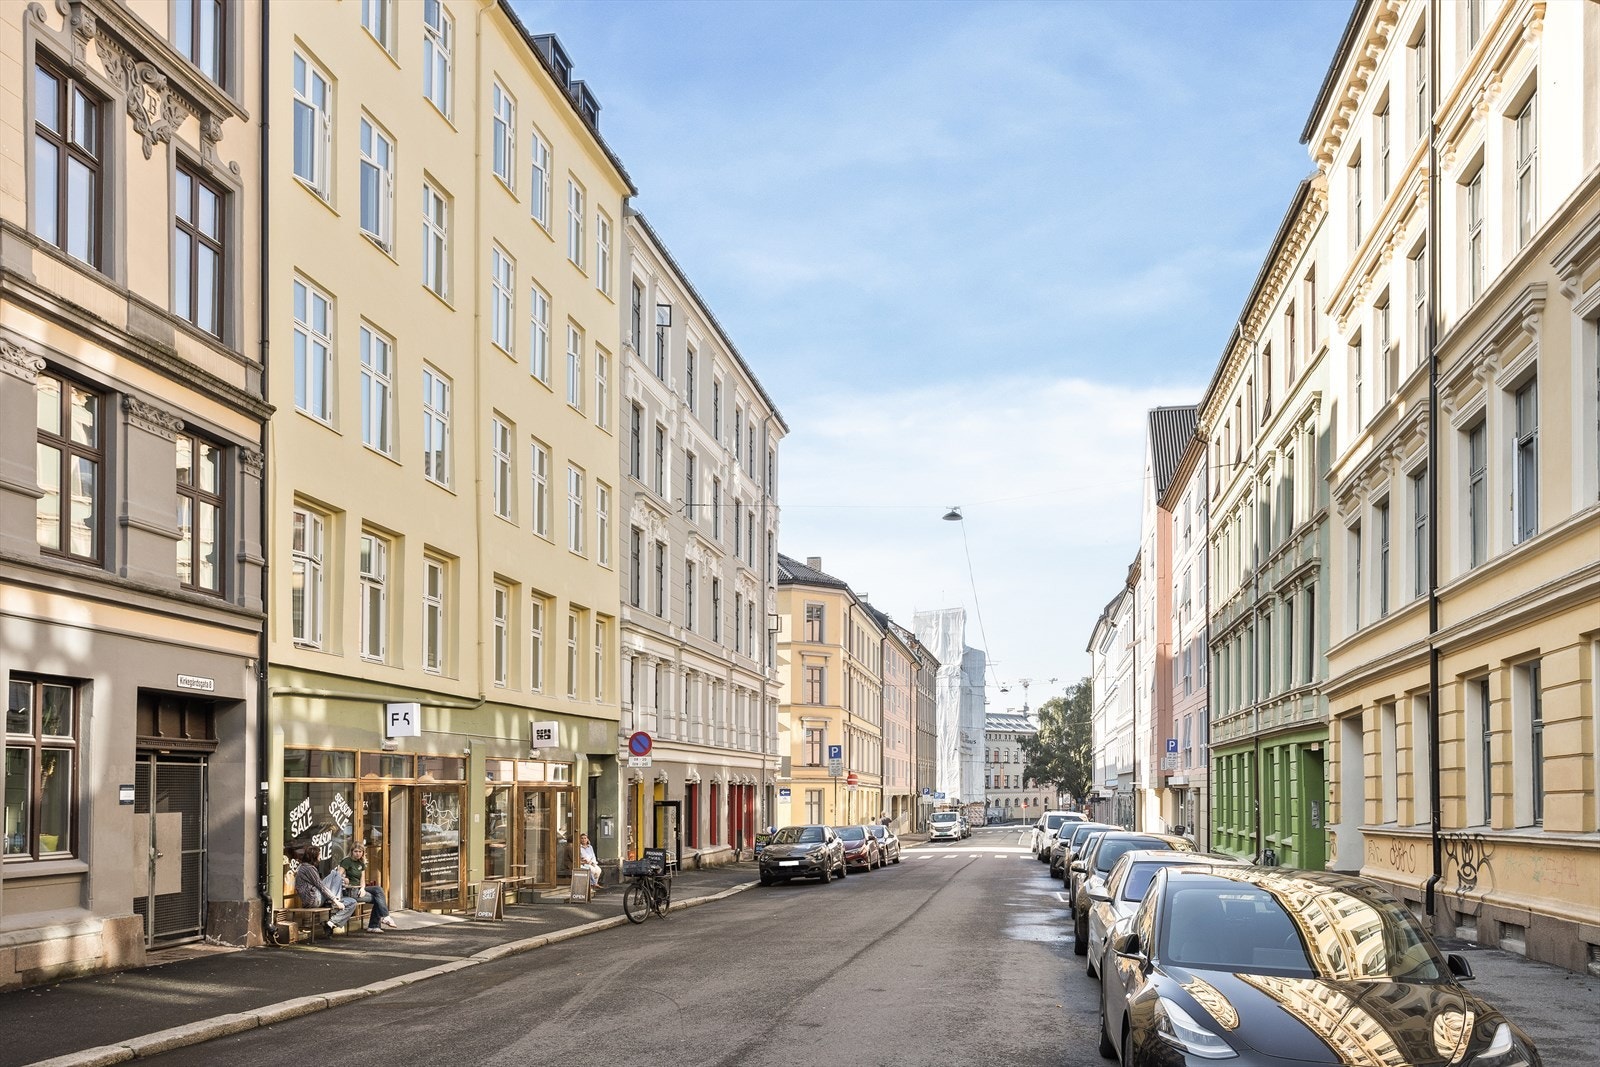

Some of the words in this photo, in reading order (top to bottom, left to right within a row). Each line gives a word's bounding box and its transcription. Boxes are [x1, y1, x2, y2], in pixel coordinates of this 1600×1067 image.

[831, 746, 838, 757] P
[1169, 741, 1175, 751] P
[290, 797, 310, 821] SEASON
[335, 792, 353, 818] SEASON
[291, 808, 313, 838] SALE
[329, 801, 349, 831] SALE
[312, 830, 332, 846] SEASON
[319, 841, 332, 860] ALE
